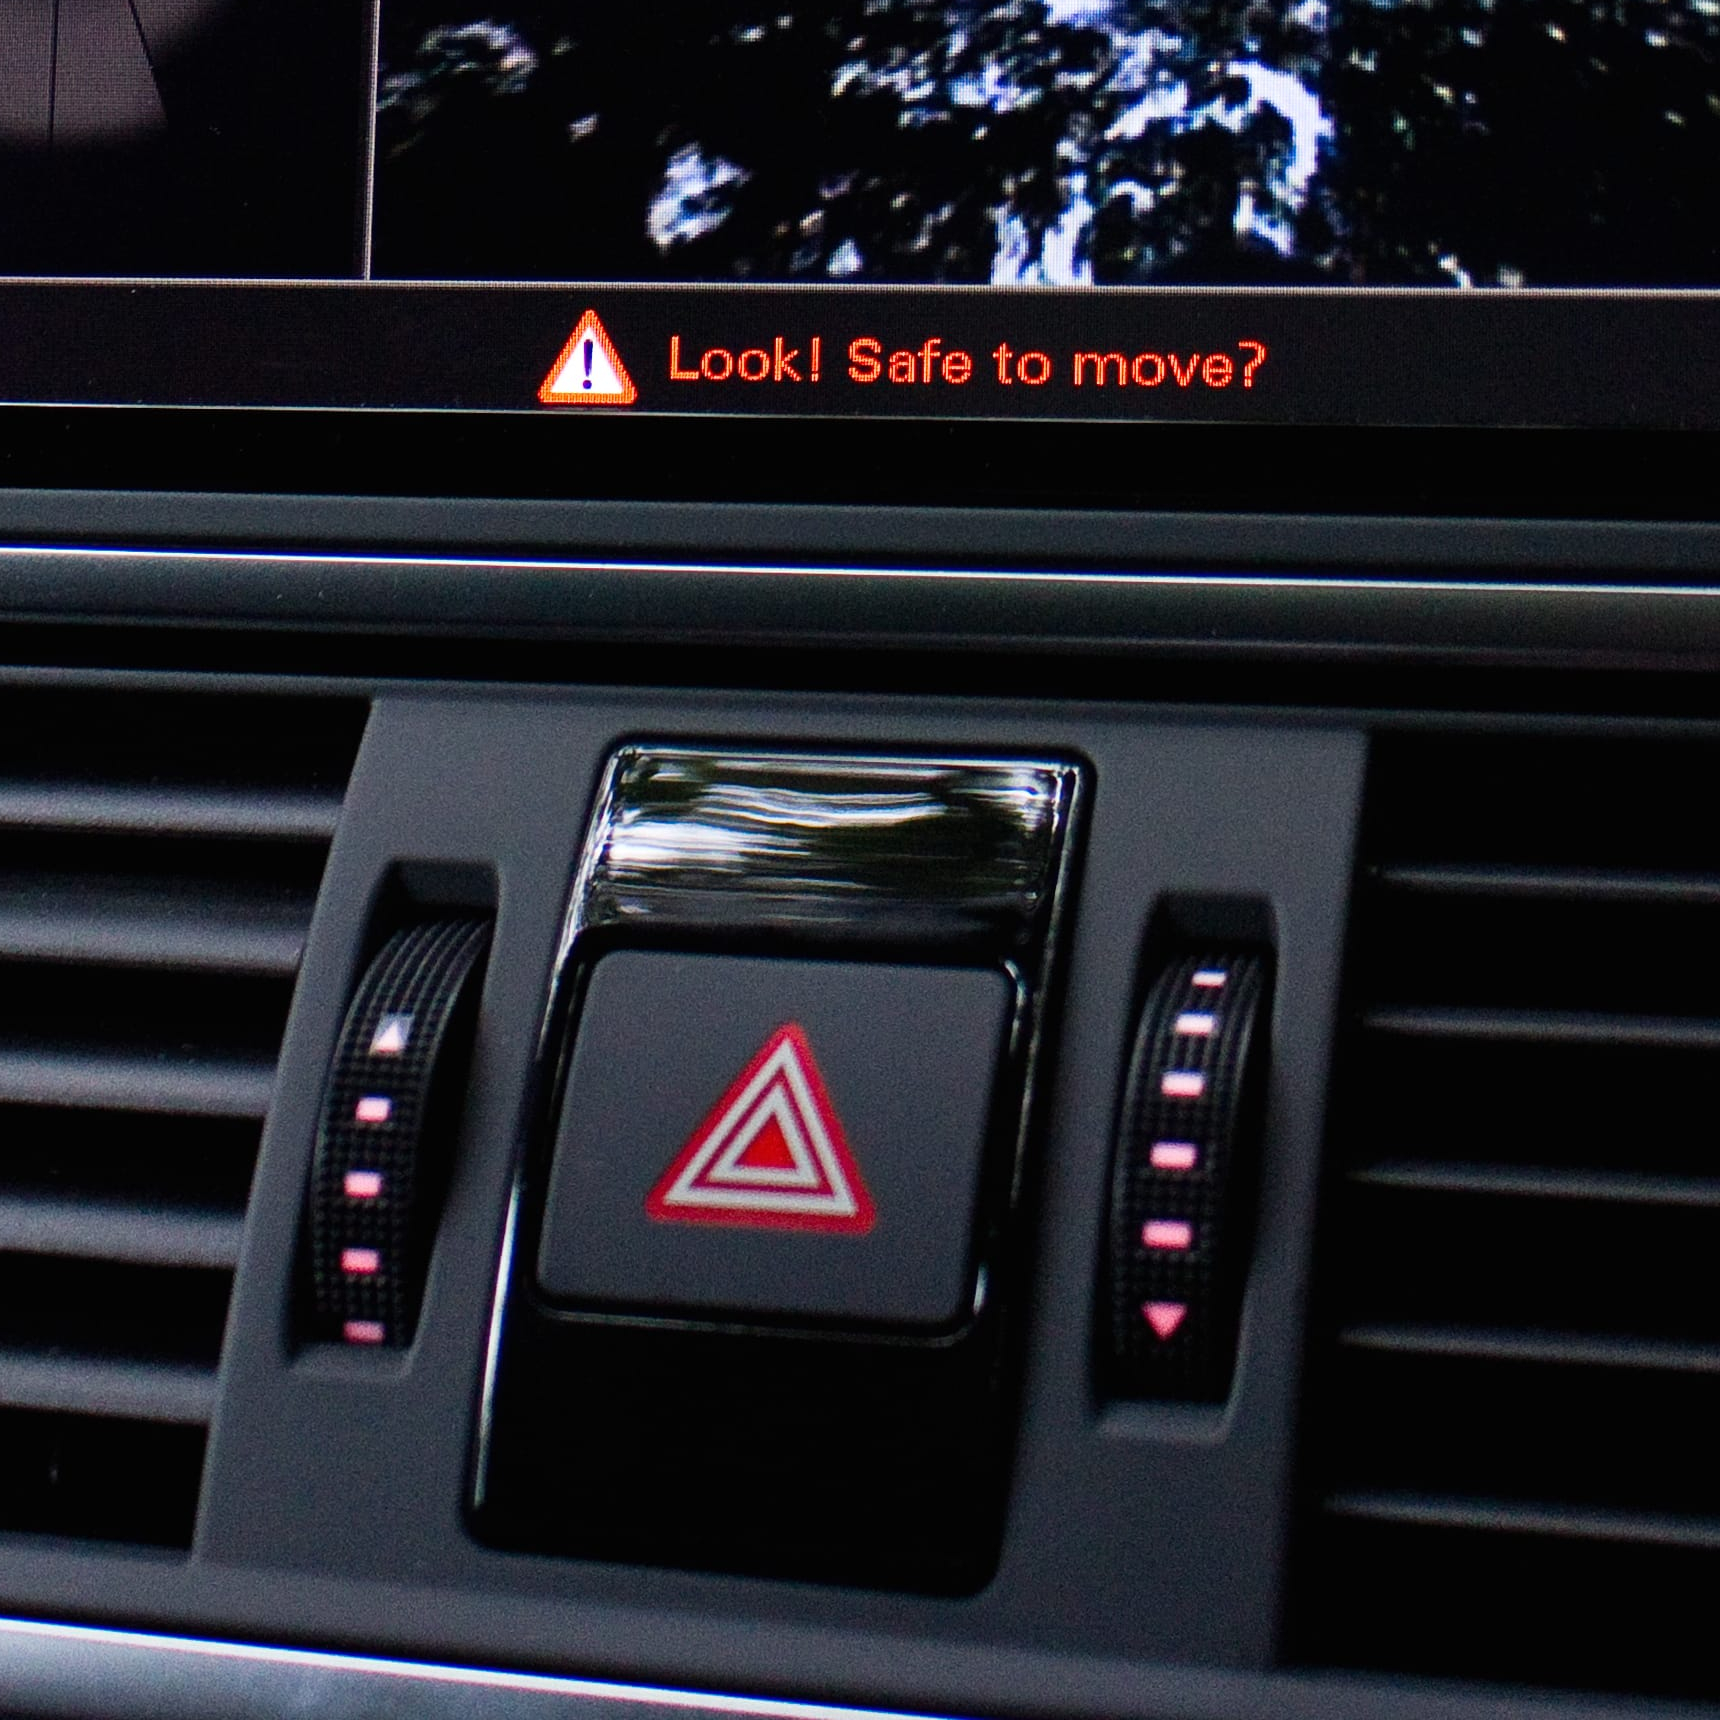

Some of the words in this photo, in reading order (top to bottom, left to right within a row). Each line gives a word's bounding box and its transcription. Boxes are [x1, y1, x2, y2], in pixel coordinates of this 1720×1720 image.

[669, 335, 822, 383] Look!
[847, 336, 974, 386] Safe
[992, 342, 1053, 387] to
[1073, 339, 1268, 390] move?
